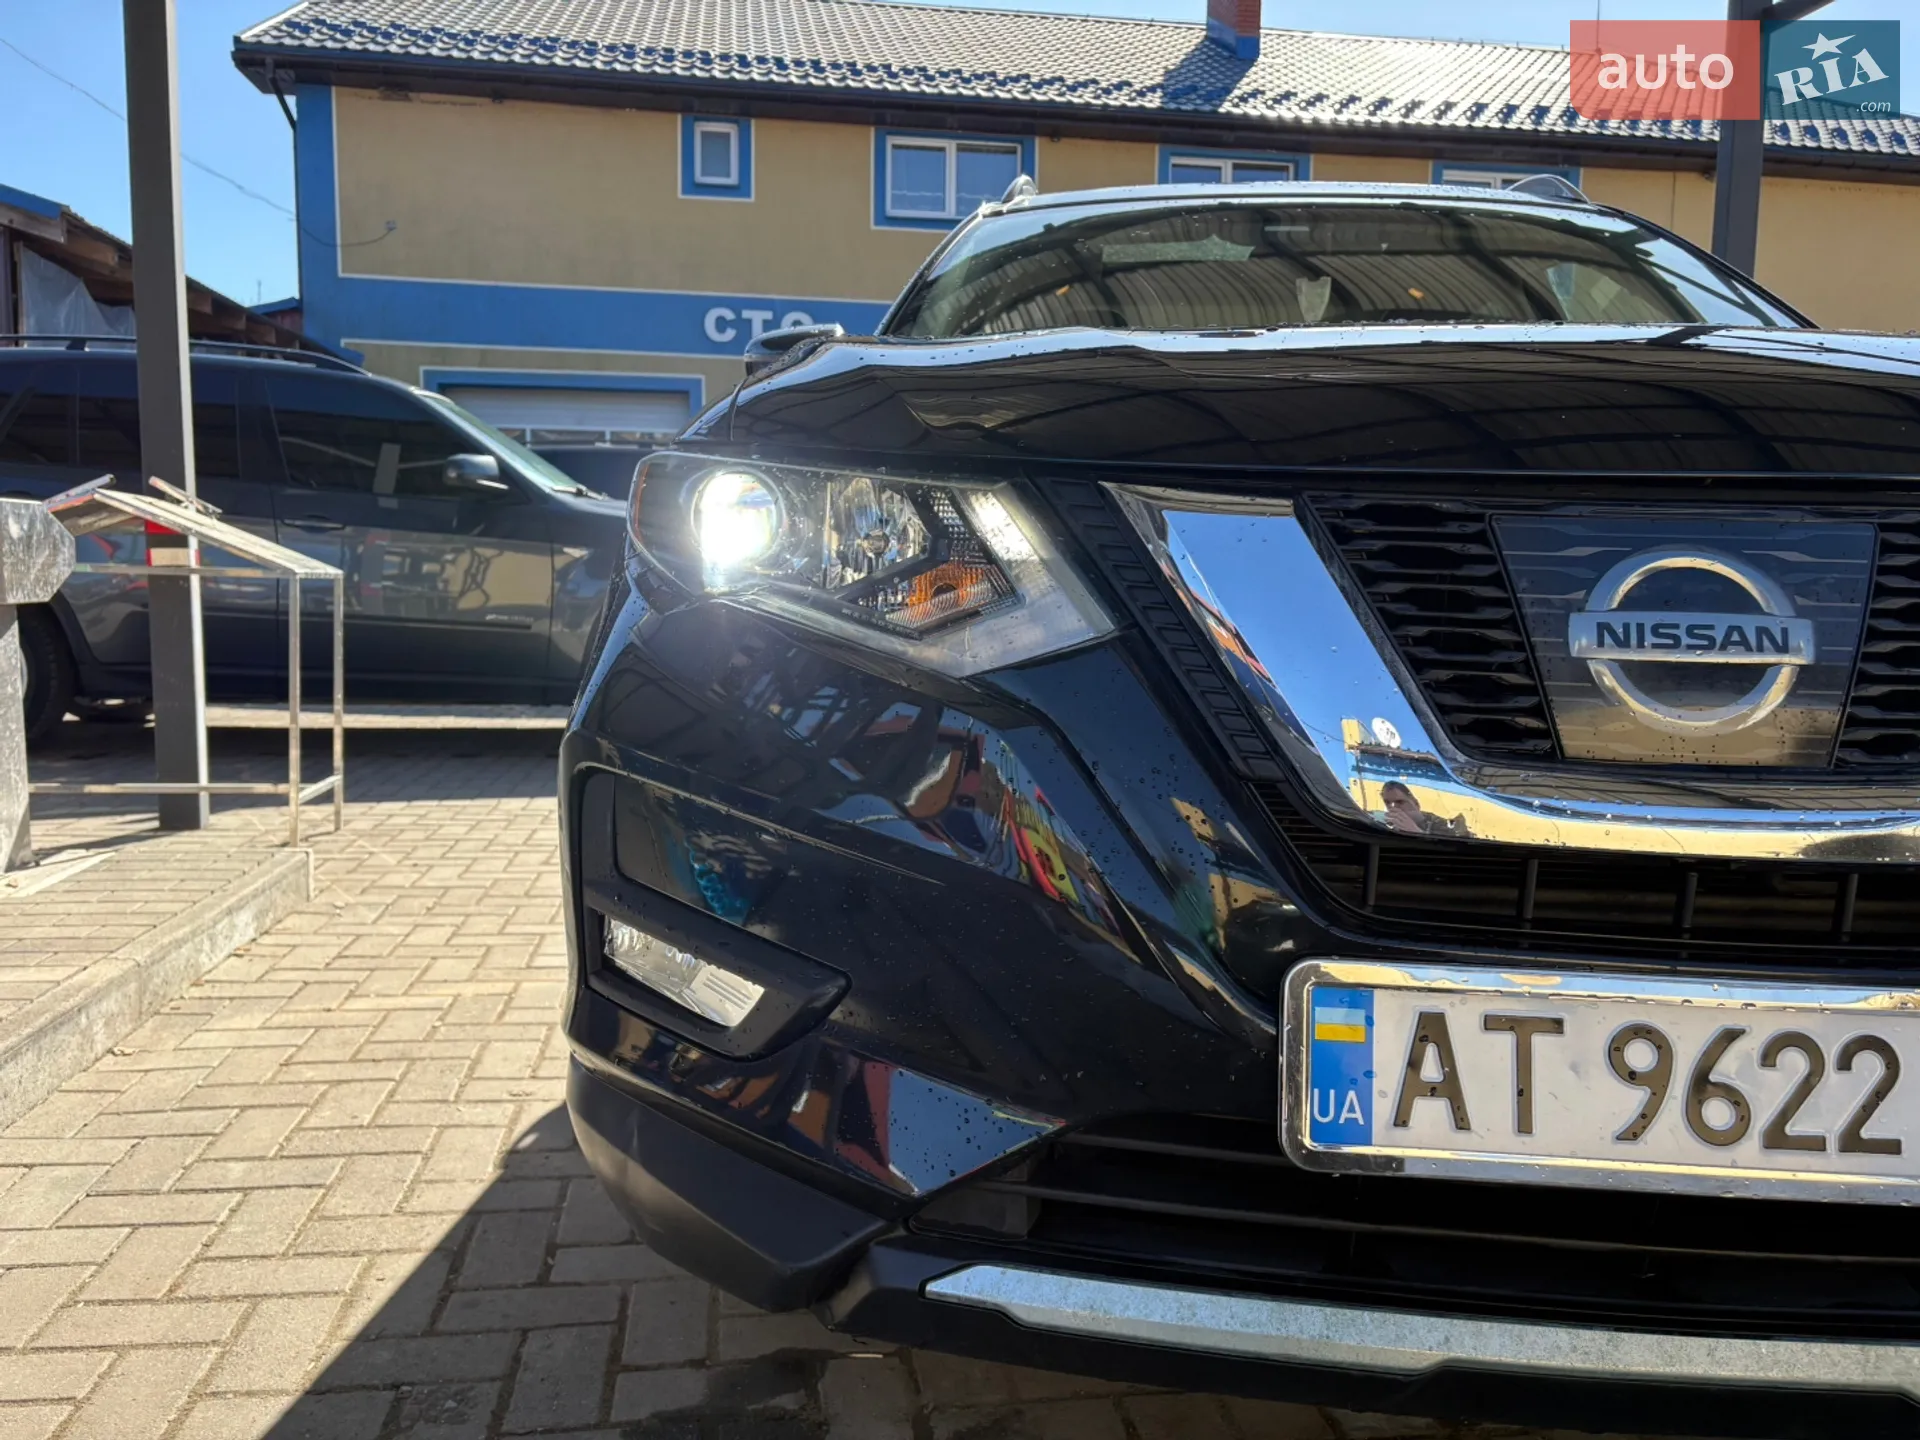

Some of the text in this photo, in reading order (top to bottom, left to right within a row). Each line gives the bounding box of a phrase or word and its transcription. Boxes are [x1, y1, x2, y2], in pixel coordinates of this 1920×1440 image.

[1596, 621, 1789, 653] NISSAN
[1393, 1012, 1902, 1155] AT 9622
[1313, 1088, 1365, 1125] UA
